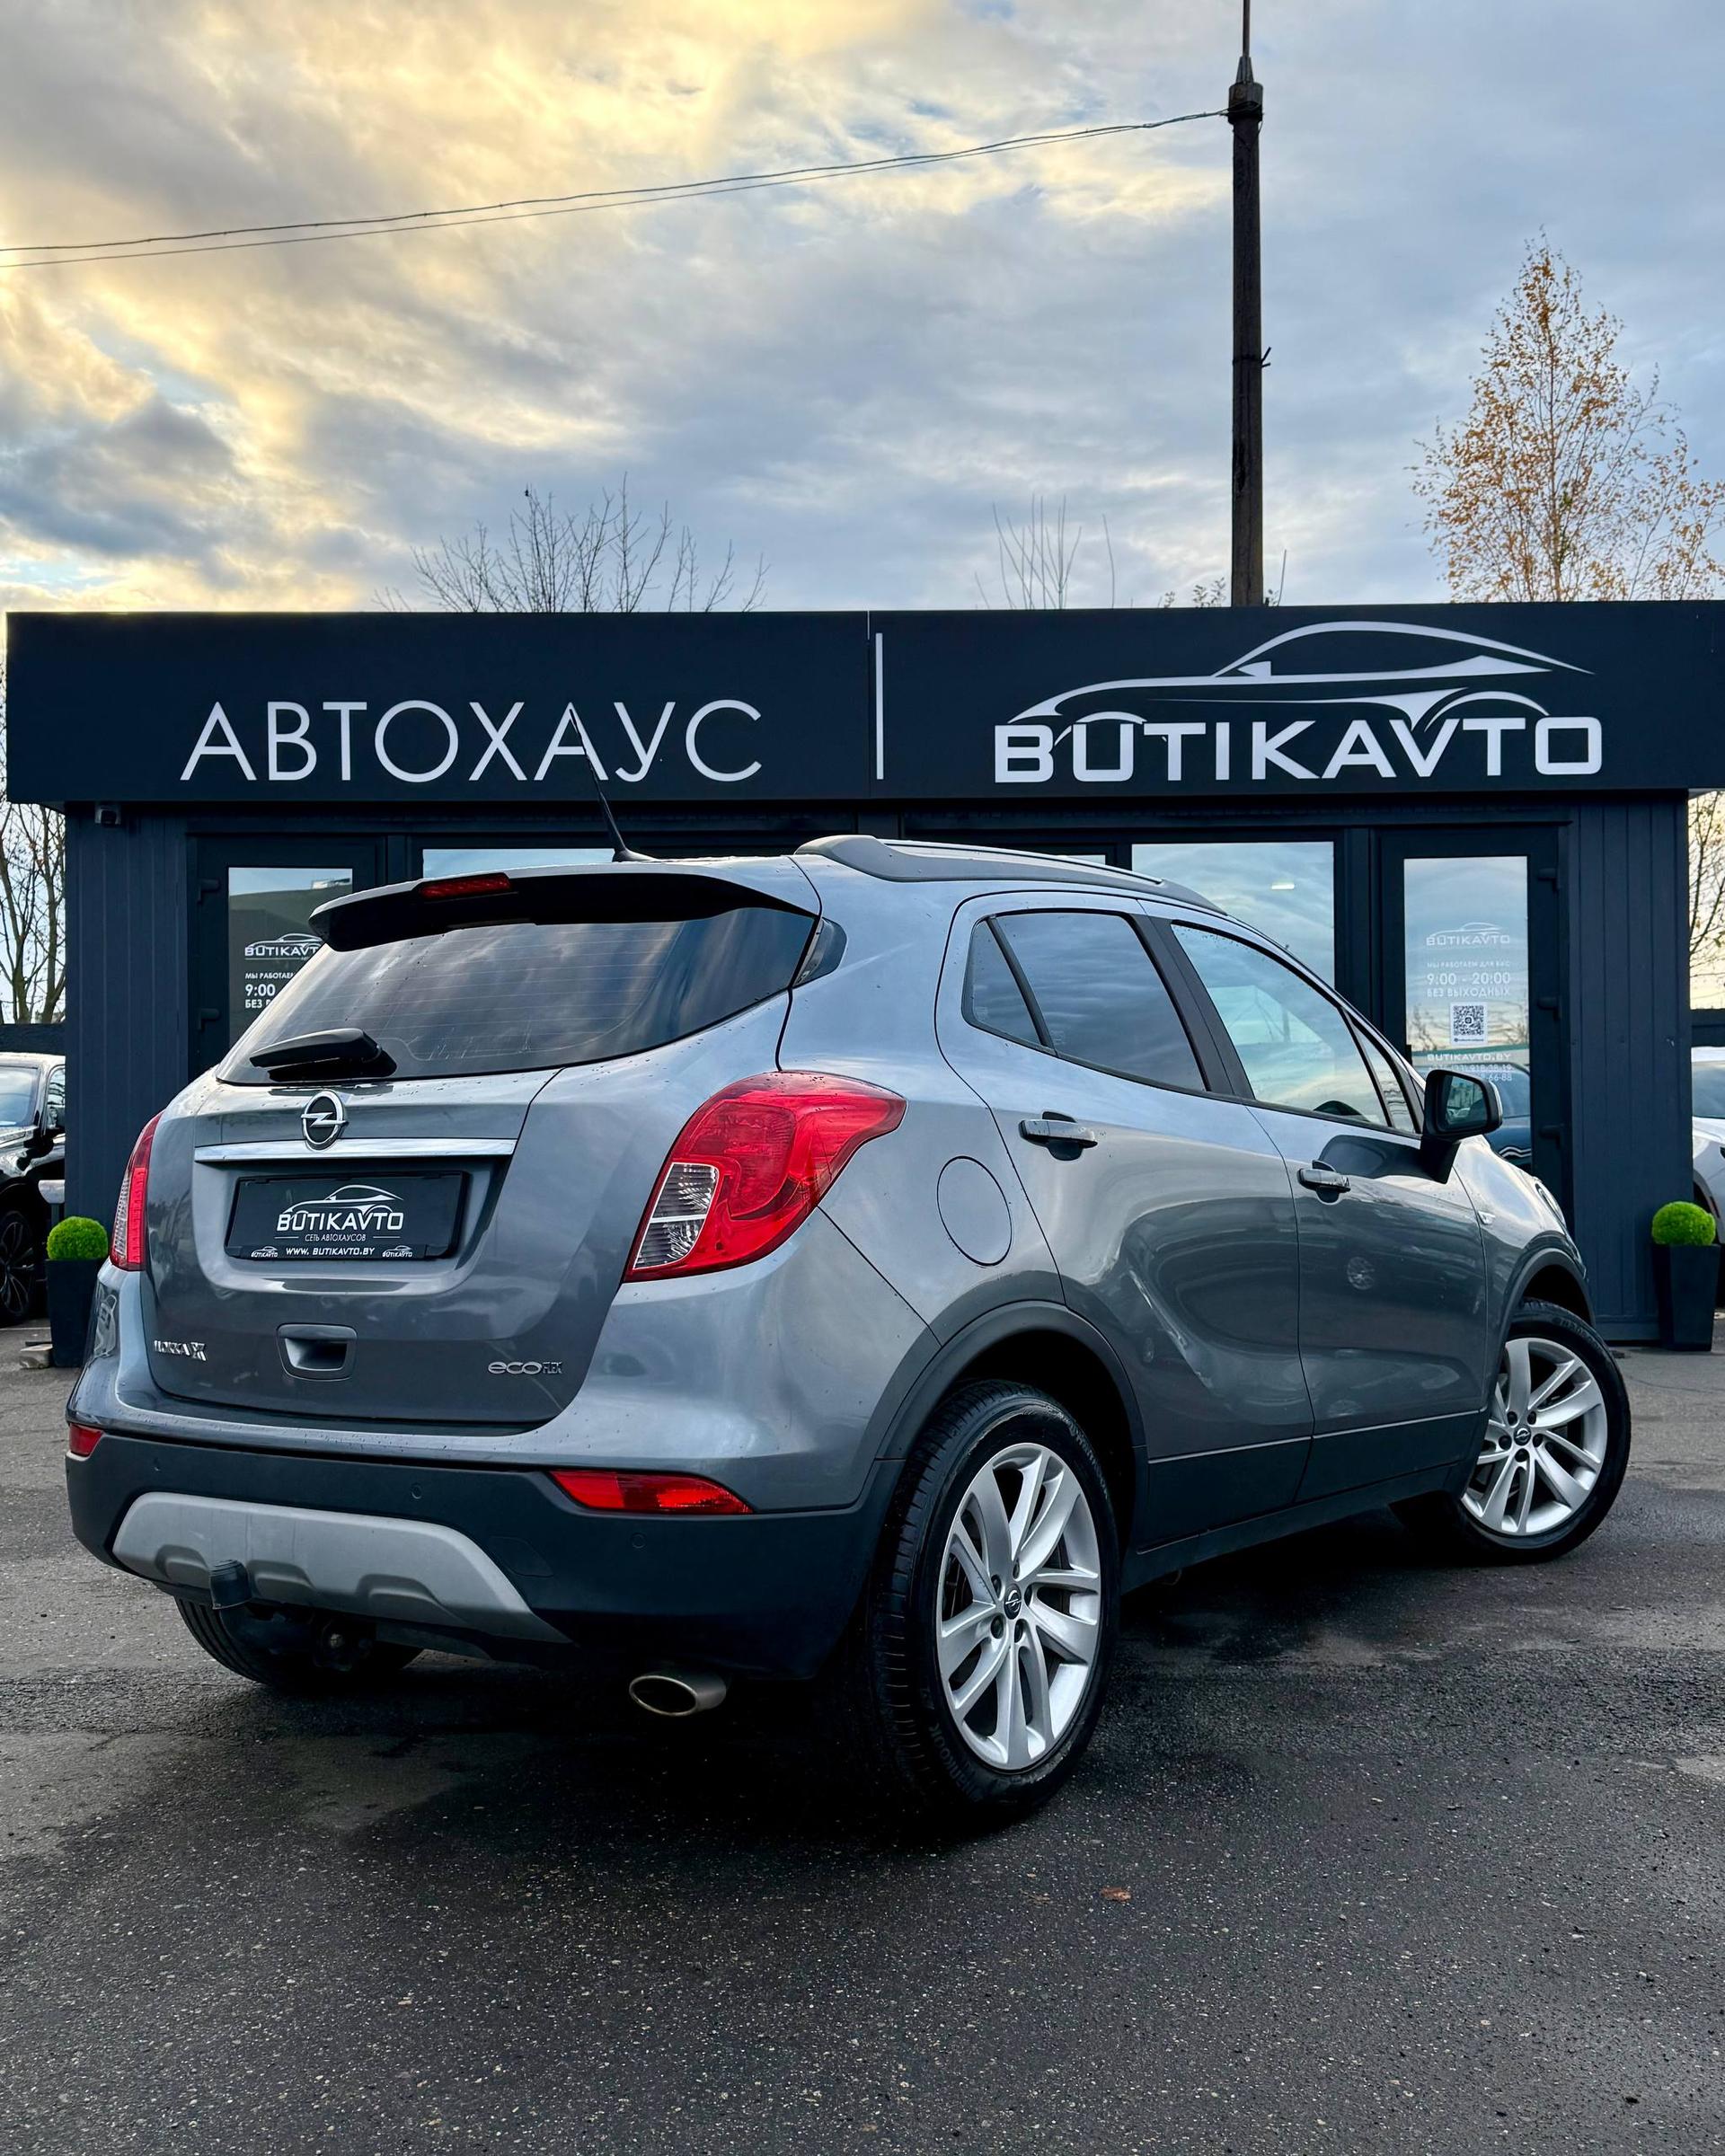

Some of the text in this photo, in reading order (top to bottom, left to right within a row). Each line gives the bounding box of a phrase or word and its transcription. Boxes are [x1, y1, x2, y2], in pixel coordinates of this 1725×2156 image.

[180, 699, 763, 782] АВТОХАУС
[995, 716, 1603, 783] BUTIKAVTO
[1426, 935, 1510, 946] BUTIKAVTO
[244, 946, 318, 956] BUTIKAVT
[1427, 973, 1456, 985] 9:00
[1472, 972, 1510, 985] 20:00
[245, 984, 275, 996] 9:00
[1427, 987, 1510, 997] БЕЗ ВЫХОДНЫХ
[244, 999, 262, 1008] БЕЗ
[1427, 1053, 1511, 1061] BUTIKAVTO.BY
[277, 1212, 403, 1231] BUTIKAVTO
[321, 1233, 367, 1241] АВТОХАУСОВ
[286, 1247, 376, 1256] WWW. BUTIKAVTO.BY
